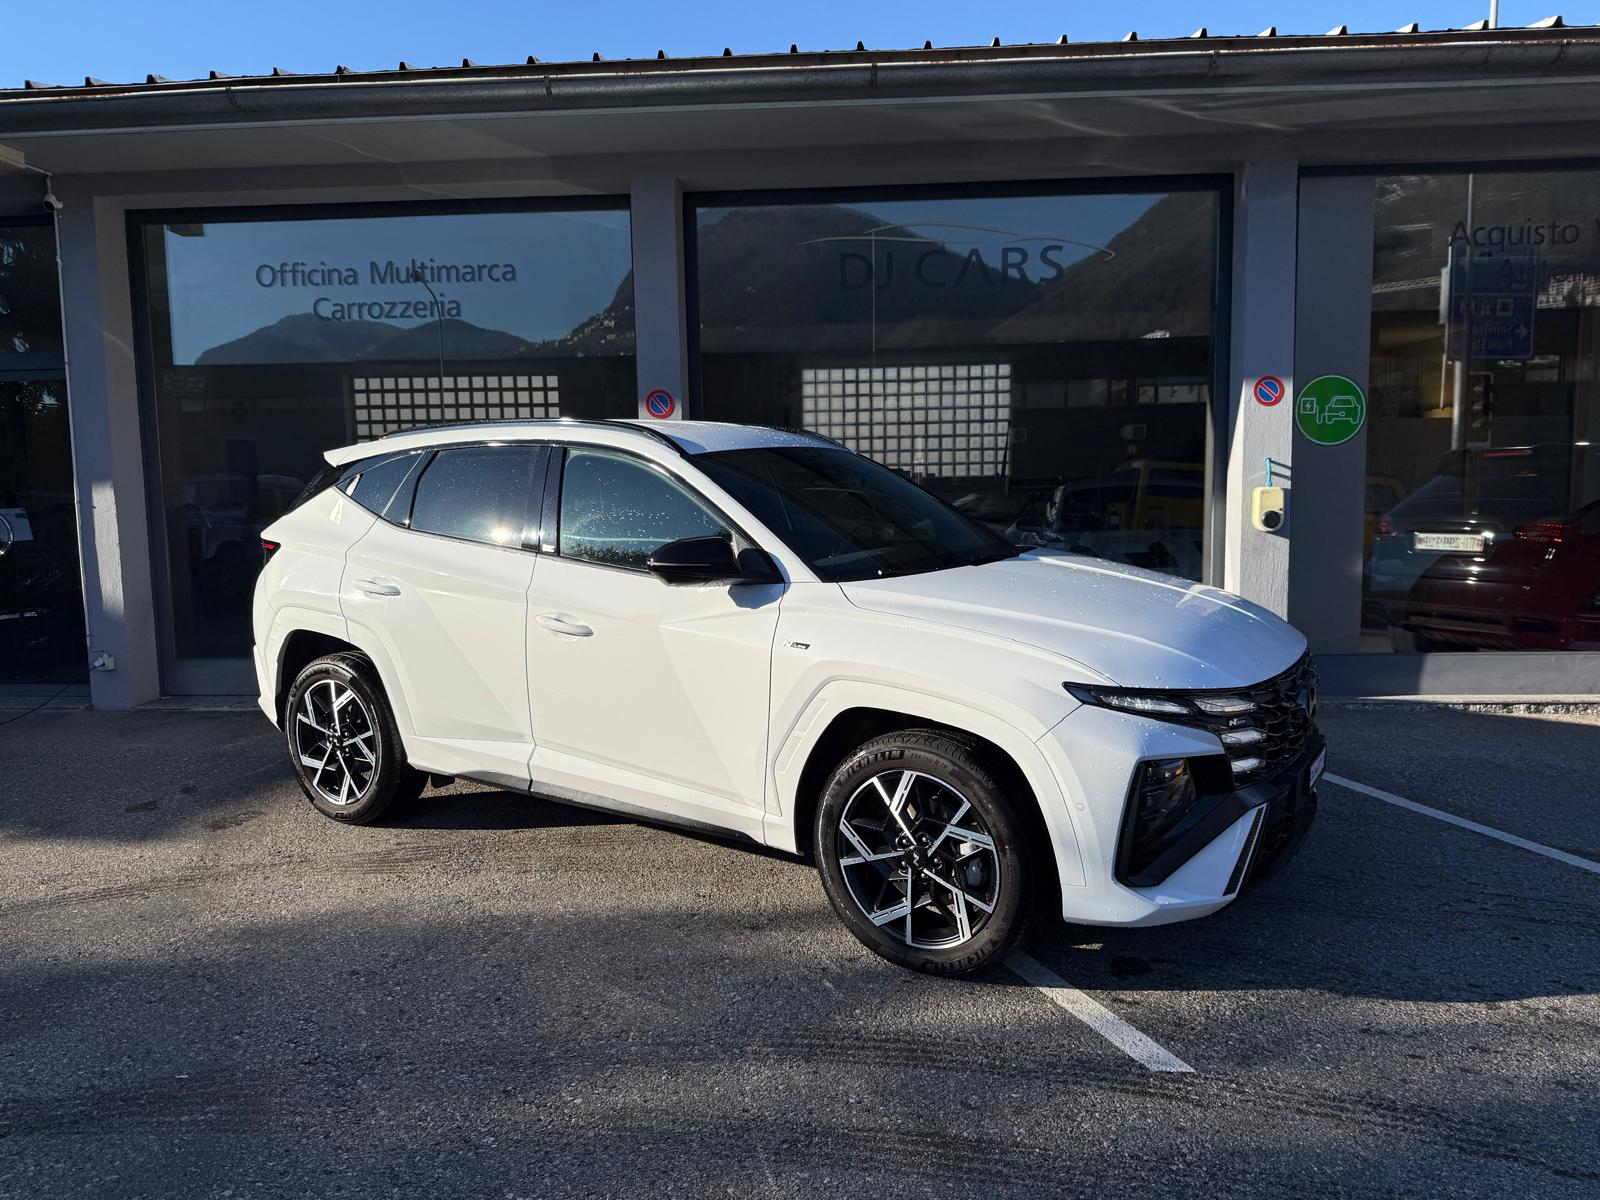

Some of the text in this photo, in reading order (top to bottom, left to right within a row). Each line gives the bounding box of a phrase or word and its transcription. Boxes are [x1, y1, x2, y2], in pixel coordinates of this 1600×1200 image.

[1448, 218, 1580, 252] Acquisto
[256, 258, 517, 288] Officina Multimarca
[839, 244, 1065, 291] DJ CARS
[313, 294, 462, 321] Carrozzeria
